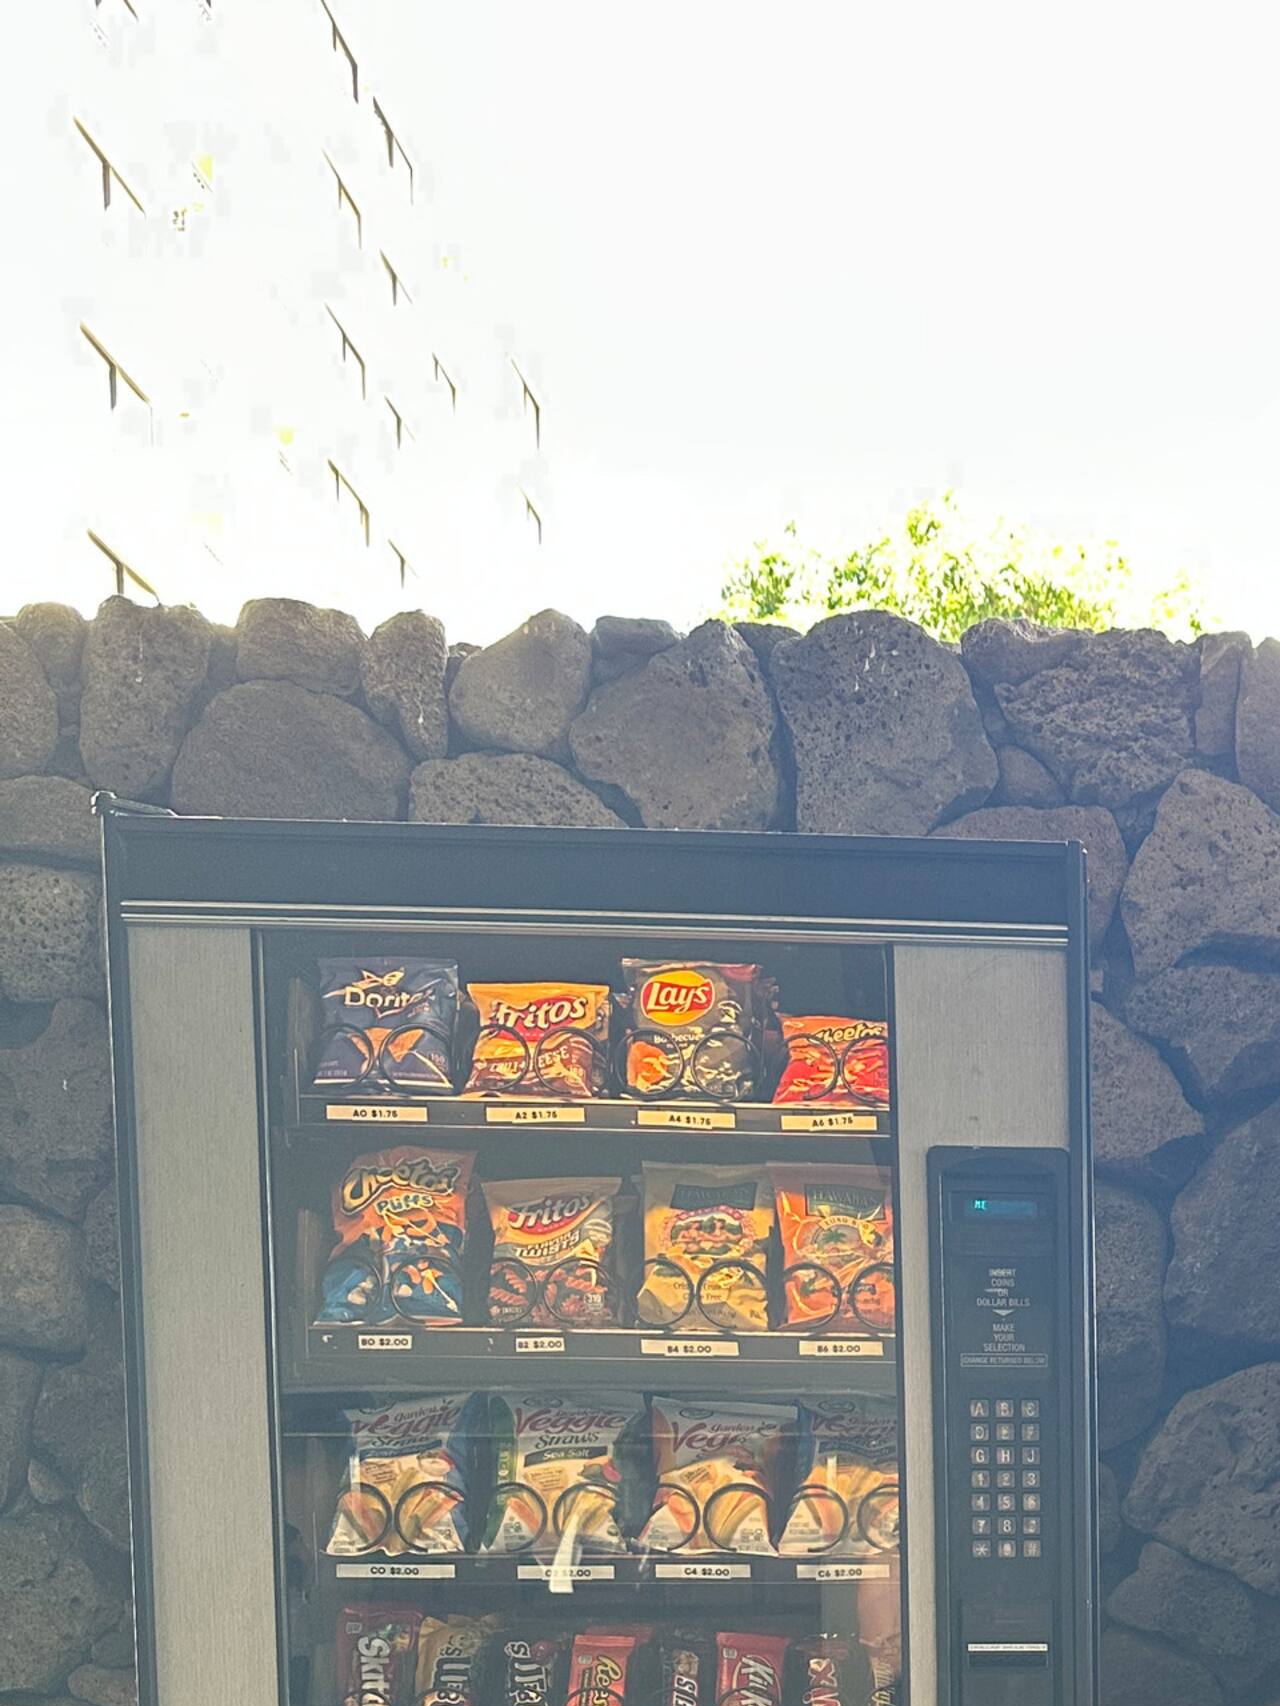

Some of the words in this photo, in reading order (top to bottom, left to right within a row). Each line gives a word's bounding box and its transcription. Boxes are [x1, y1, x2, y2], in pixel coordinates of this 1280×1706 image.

[532, 1111, 557, 1119] $1.75
[686, 1116, 711, 1125] $1.75
[828, 1117, 853, 1125] $1.75
[510, 1192, 592, 1230] Fritos
[989, 1268, 1016, 1277] INSERT
[991, 1279, 1015, 1287] COINS
[992, 1324, 1015, 1332] MAKE
[379, 1338, 409, 1346] $2.00
[993, 1334, 1015, 1342] YOUR
[533, 1340, 562, 1349] $2.00
[683, 1345, 712, 1353] $2.00
[832, 1344, 861, 1353] $2.00
[983, 1344, 1025, 1352] SELECTION
[515, 1407, 627, 1434] Veggie
[535, 1431, 600, 1449] Straws
[542, 1449, 563, 1461] Sea
[390, 1567, 419, 1575] $2.00
[701, 1568, 730, 1577] $2.00
[834, 1568, 862, 1577] $2.00
